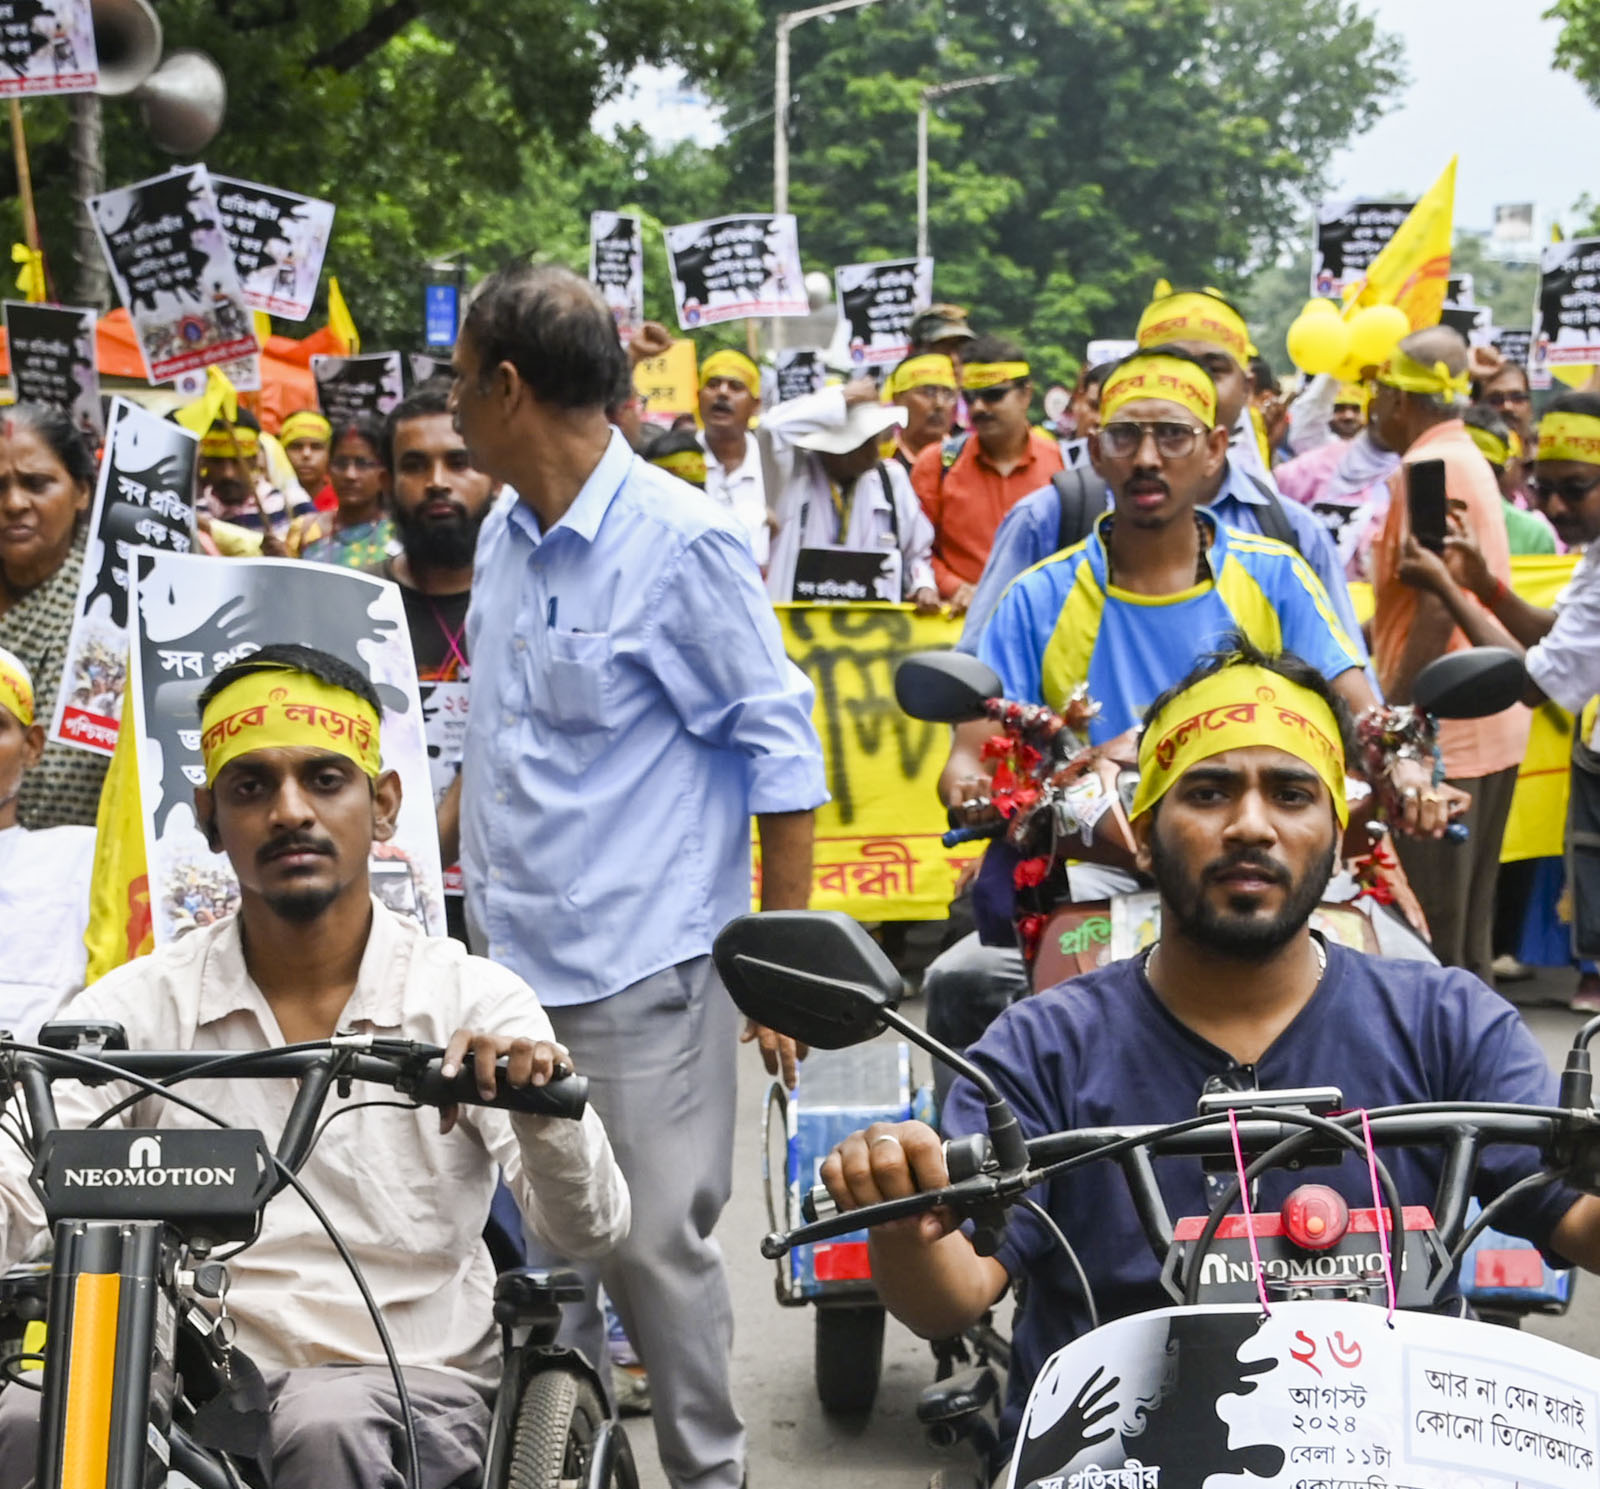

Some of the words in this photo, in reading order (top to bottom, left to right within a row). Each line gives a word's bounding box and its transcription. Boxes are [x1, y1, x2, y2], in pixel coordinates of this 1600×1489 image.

[117, 474, 147, 506] সব
[135, 518, 169, 546] এক
[158, 649, 206, 679] সব
[281, 703, 372, 760] লড়াই
[63, 1166, 237, 1187] NEOMOTION
[1289, 1329, 1363, 1378] ২৬
[1288, 1381, 1368, 1410] আগস্ট
[1424, 1369, 1469, 1399] আর
[1475, 1377, 1497, 1407] না
[1504, 1384, 1539, 1413] যেন
[1543, 1391, 1587, 1434] হারাই
[1292, 1414, 1357, 1435] ২০২৪
[1415, 1408, 1484, 1446] কোনো
[1489, 1412, 1595, 1472] তিলোত্তমাকে
[1290, 1444, 1336, 1467] বেলা
[1345, 1443, 1392, 1468] ১১টা
